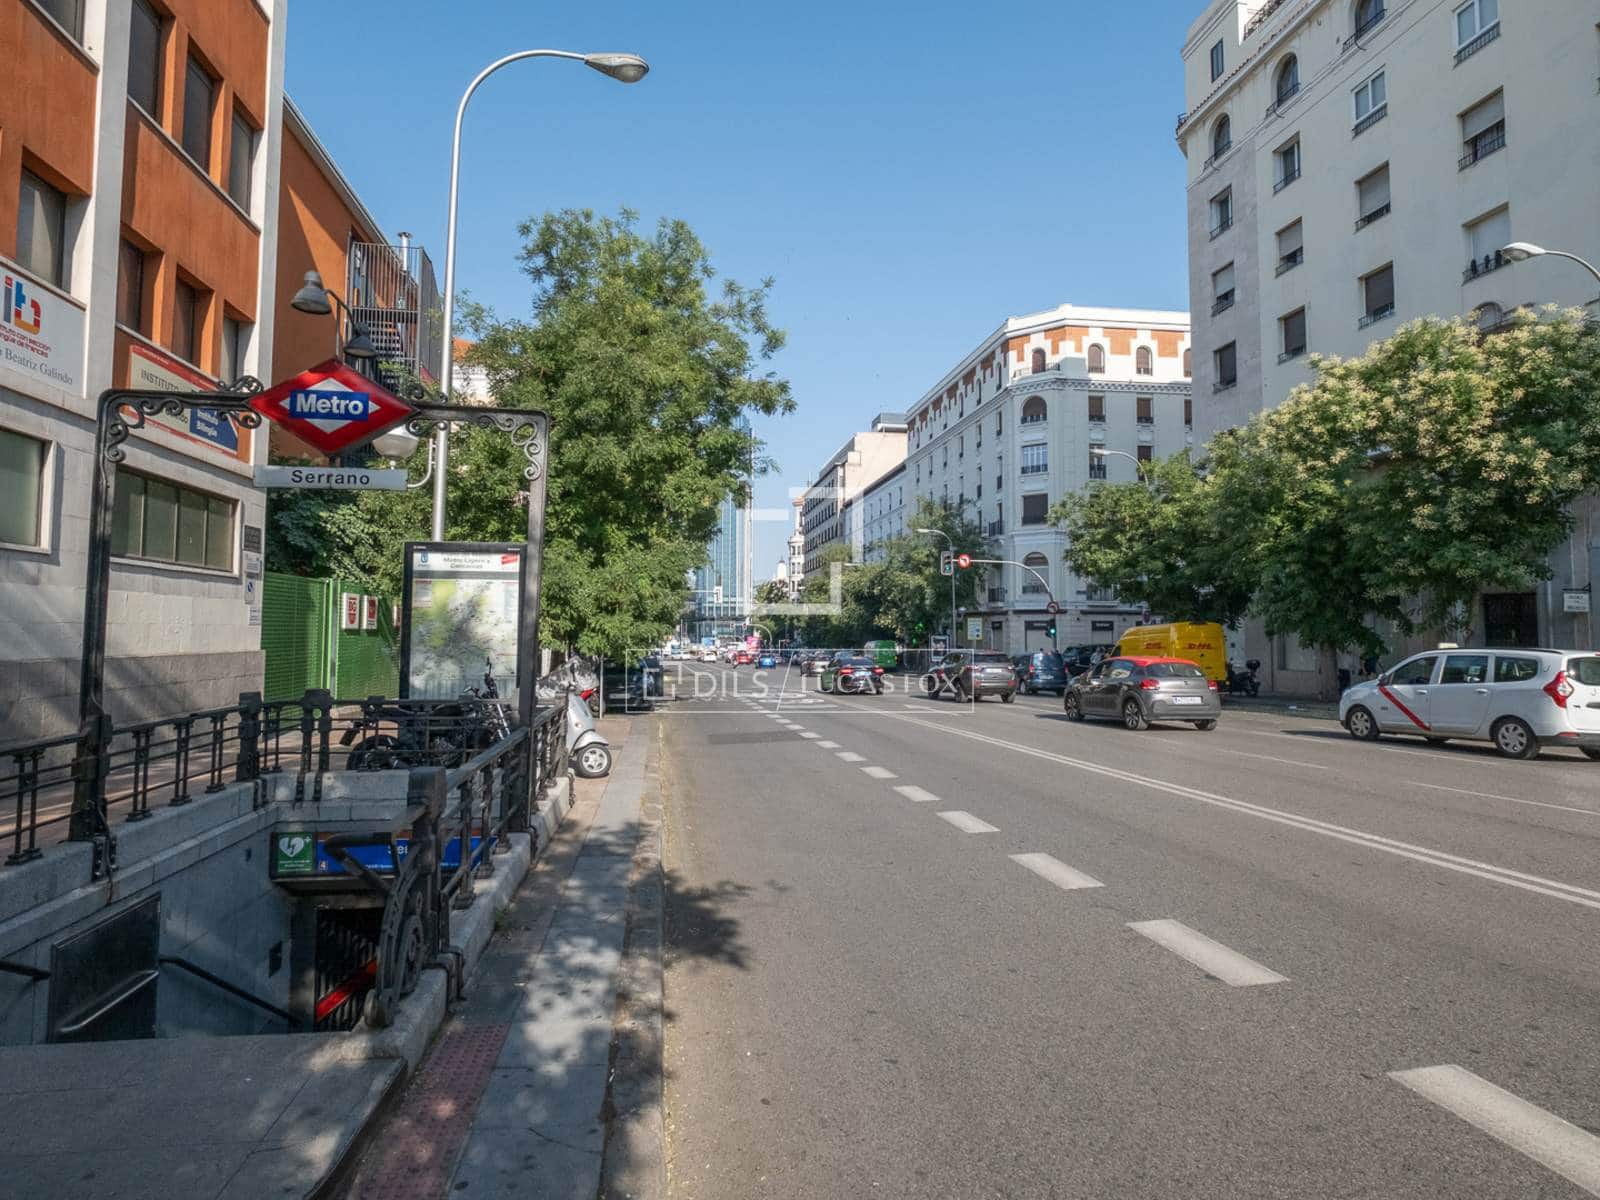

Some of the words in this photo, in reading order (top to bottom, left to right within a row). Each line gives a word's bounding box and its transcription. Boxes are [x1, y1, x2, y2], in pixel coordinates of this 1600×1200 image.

[5, 348, 38, 370] Beatriz
[40, 363, 73, 385] Galindo
[141, 368, 179, 392] INSTITUTO
[295, 393, 365, 416] Metro
[291, 469, 370, 486] Serrano
